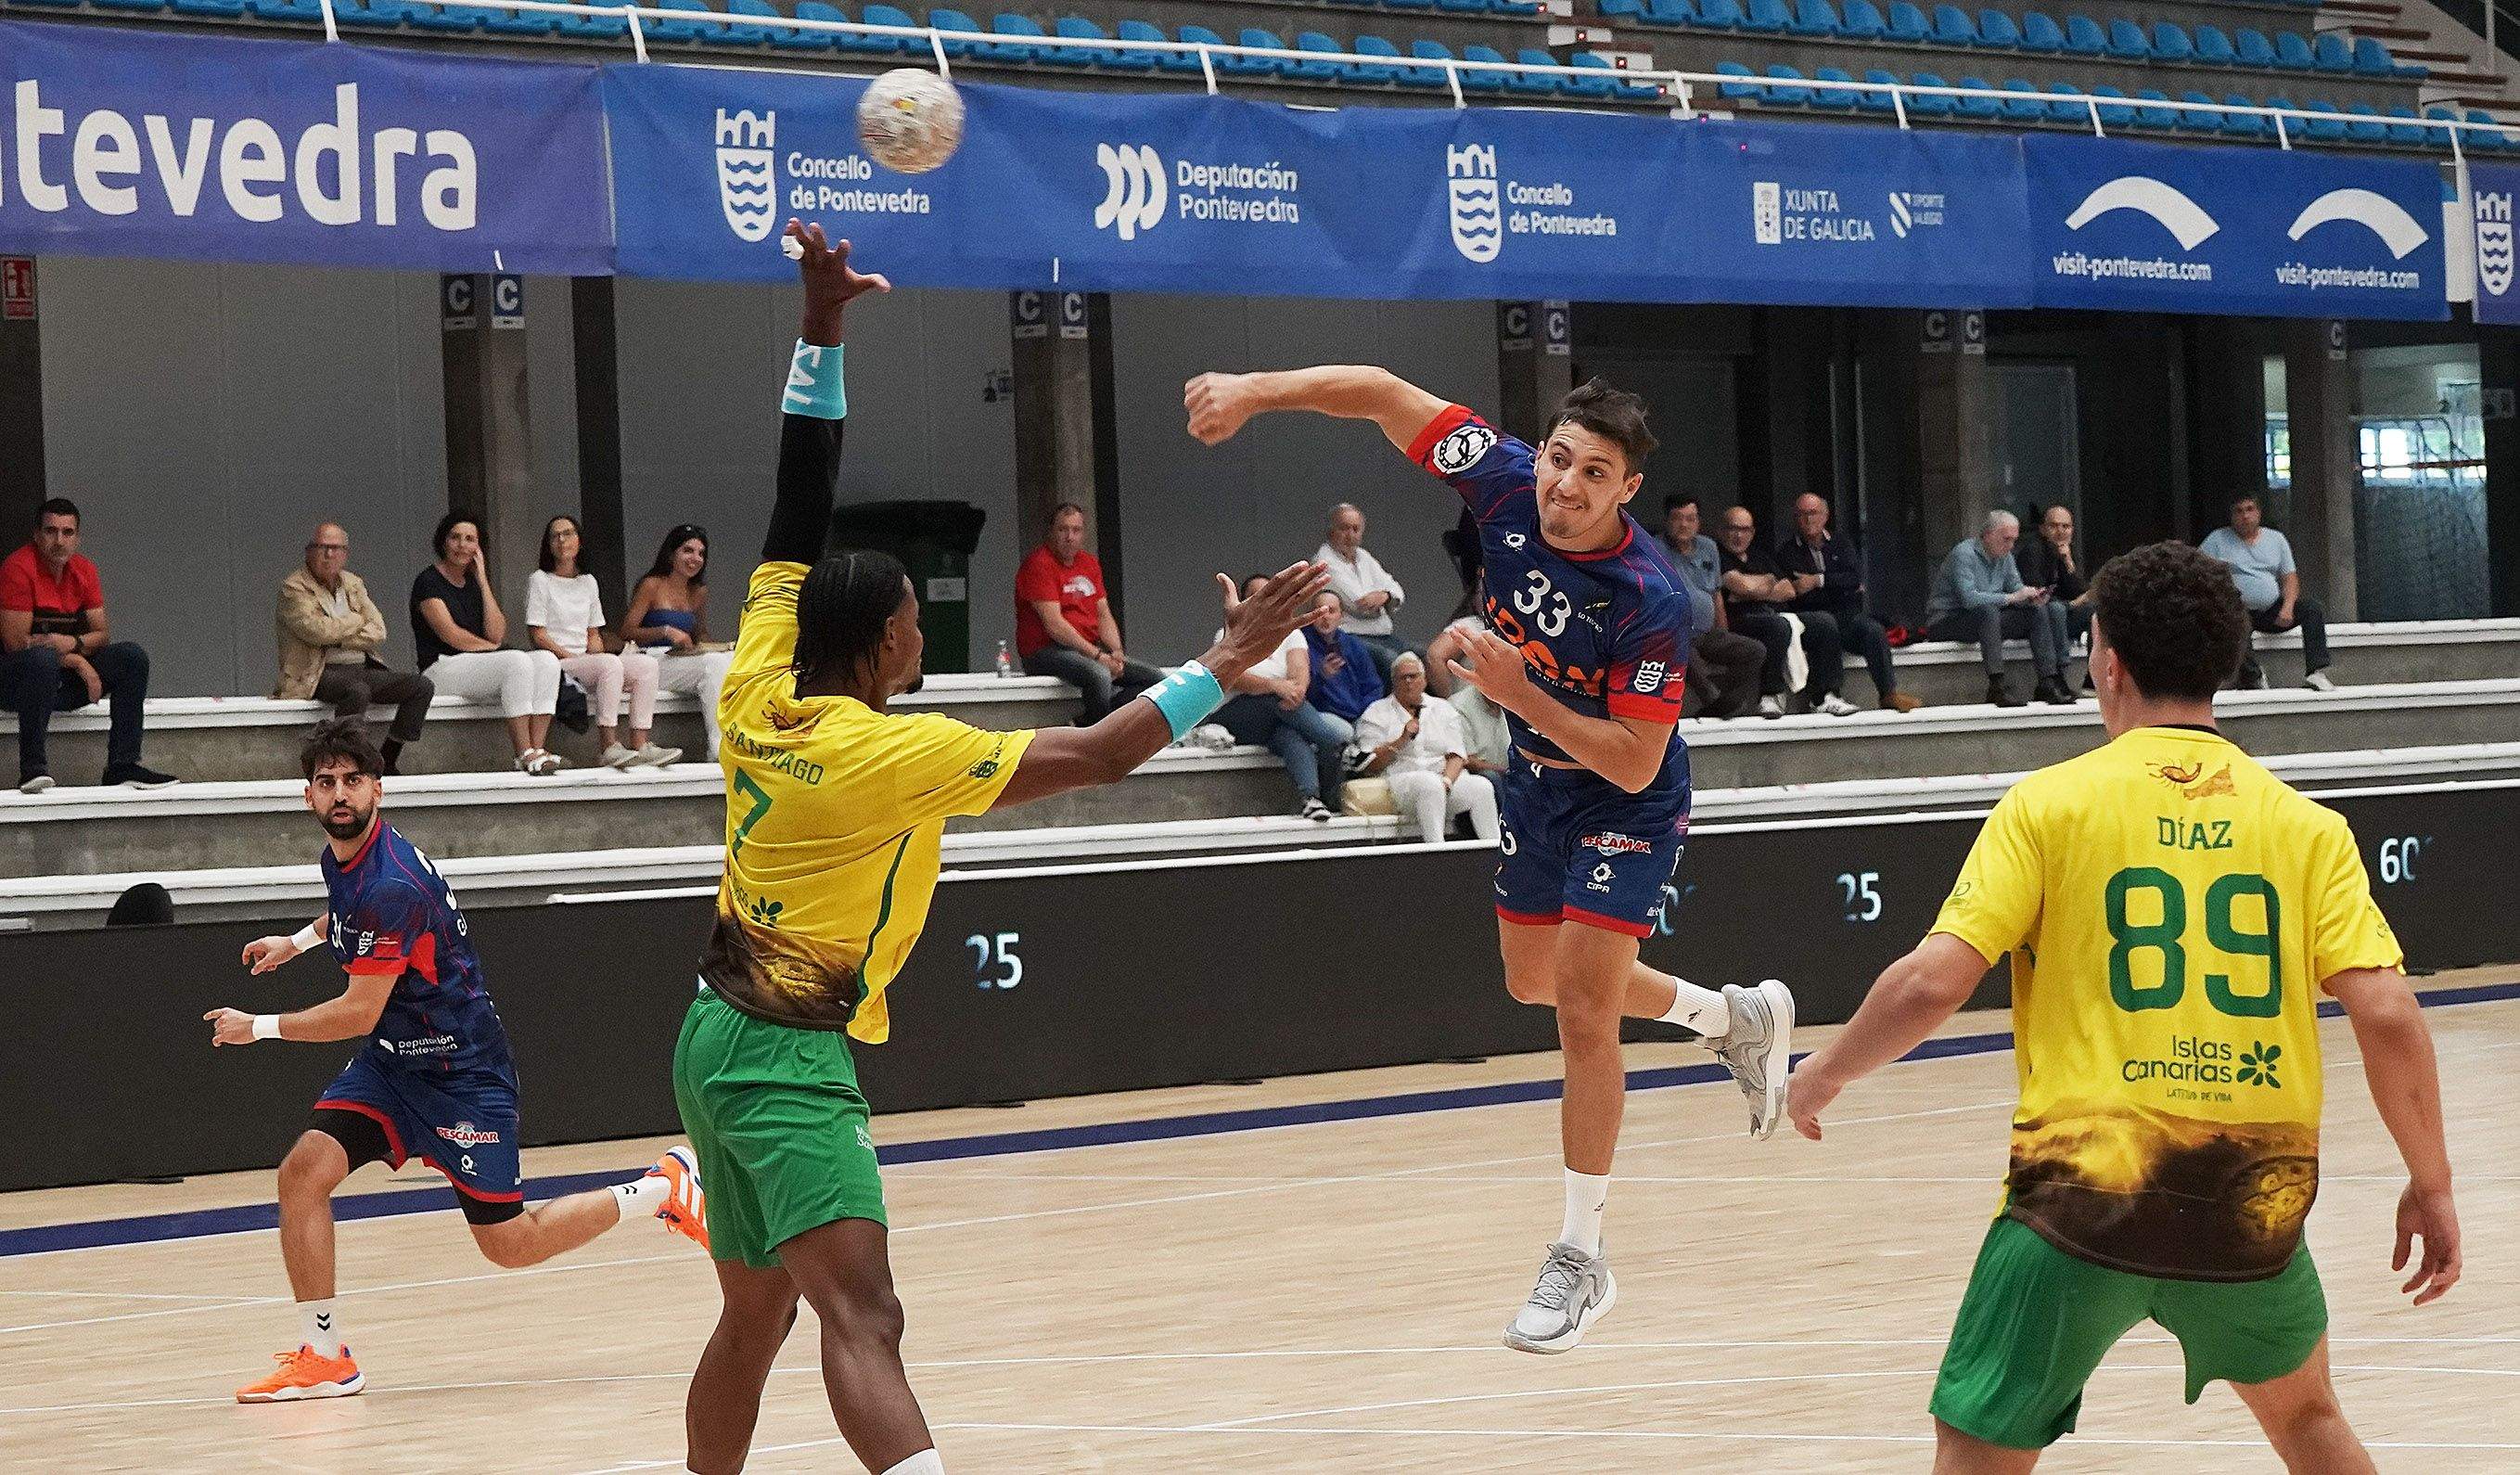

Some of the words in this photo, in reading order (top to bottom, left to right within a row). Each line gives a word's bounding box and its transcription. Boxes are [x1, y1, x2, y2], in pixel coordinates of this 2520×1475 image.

[0, 80, 477, 230] tevedra
[787, 151, 873, 181] Concello
[1177, 160, 1298, 193] Deputación
[789, 186, 816, 211] de
[819, 186, 930, 213] Pontevedra
[1506, 180, 1573, 206] Concello
[1784, 189, 1840, 212] XUNTA
[1179, 196, 1299, 224] Pontevedra
[1509, 212, 1529, 234] de
[1530, 212, 1617, 237] Pontevedra
[1784, 216, 1806, 239] DE
[1810, 217, 1875, 241] GALICIA
[2053, 251, 2212, 282] visit-pontevedra.com
[2275, 262, 2420, 290] visit-pontevedra.com
[448, 279, 471, 312] C
[496, 278, 518, 311] C
[1019, 291, 1041, 321] C
[1064, 292, 1082, 322] C
[1548, 312, 1565, 340] C
[1966, 314, 1981, 340] C
[1514, 570, 1573, 637] 33
[725, 722, 825, 786] SANTIAGO
[733, 766, 774, 862] 7
[2157, 815, 2233, 850] DÍAZ
[1586, 881, 1610, 893] CIPA
[2104, 866, 2283, 1018] 89
[966, 932, 1023, 989] 25
[2172, 1035, 2232, 1060] Islas
[2122, 1059, 2232, 1084] Canarias
[436, 1126, 500, 1144] PESCAMAR
